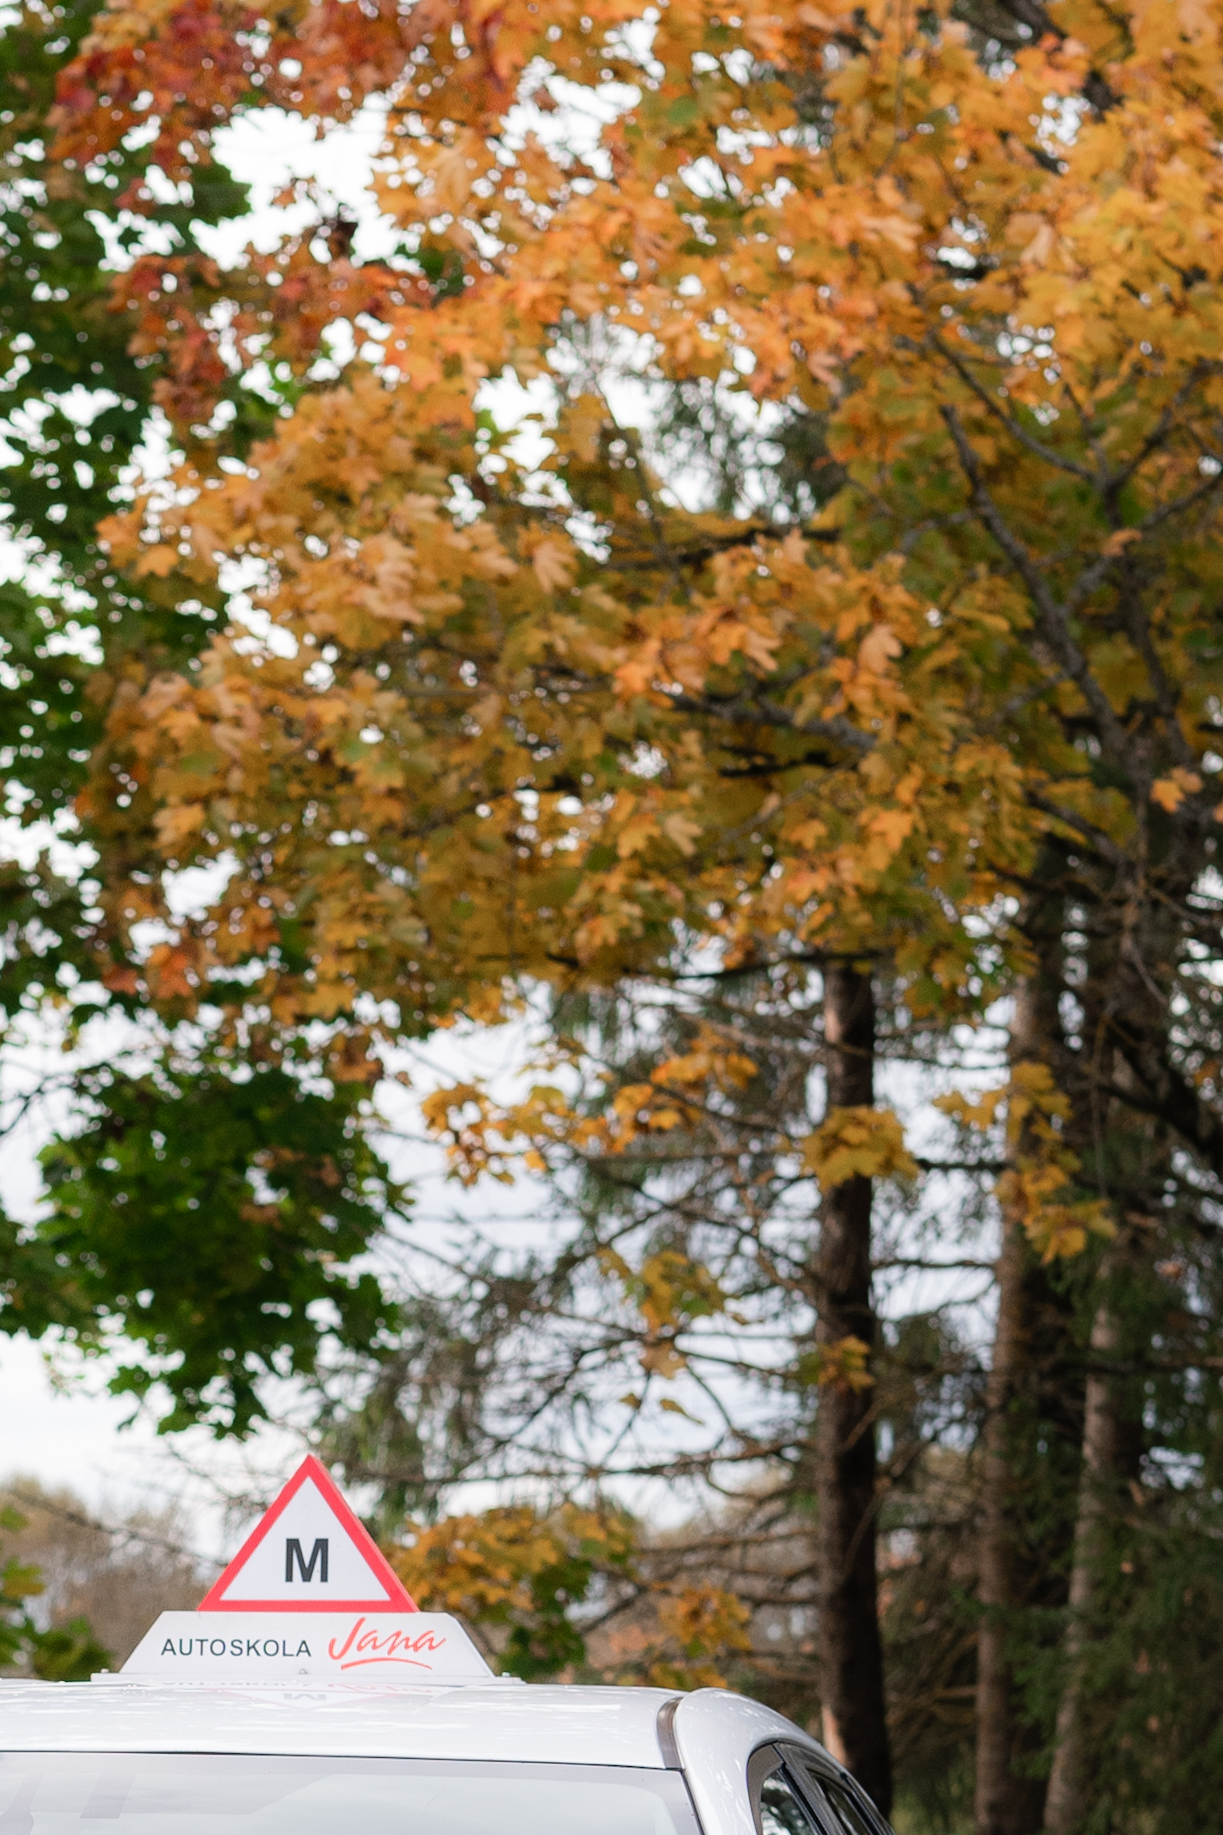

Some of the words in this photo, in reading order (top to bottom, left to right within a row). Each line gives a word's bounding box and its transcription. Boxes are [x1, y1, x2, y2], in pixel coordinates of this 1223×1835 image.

[285, 1538, 328, 1582] M
[161, 1638, 312, 1657] AUTOSKOLA
[328, 1616, 446, 1660] Jana
